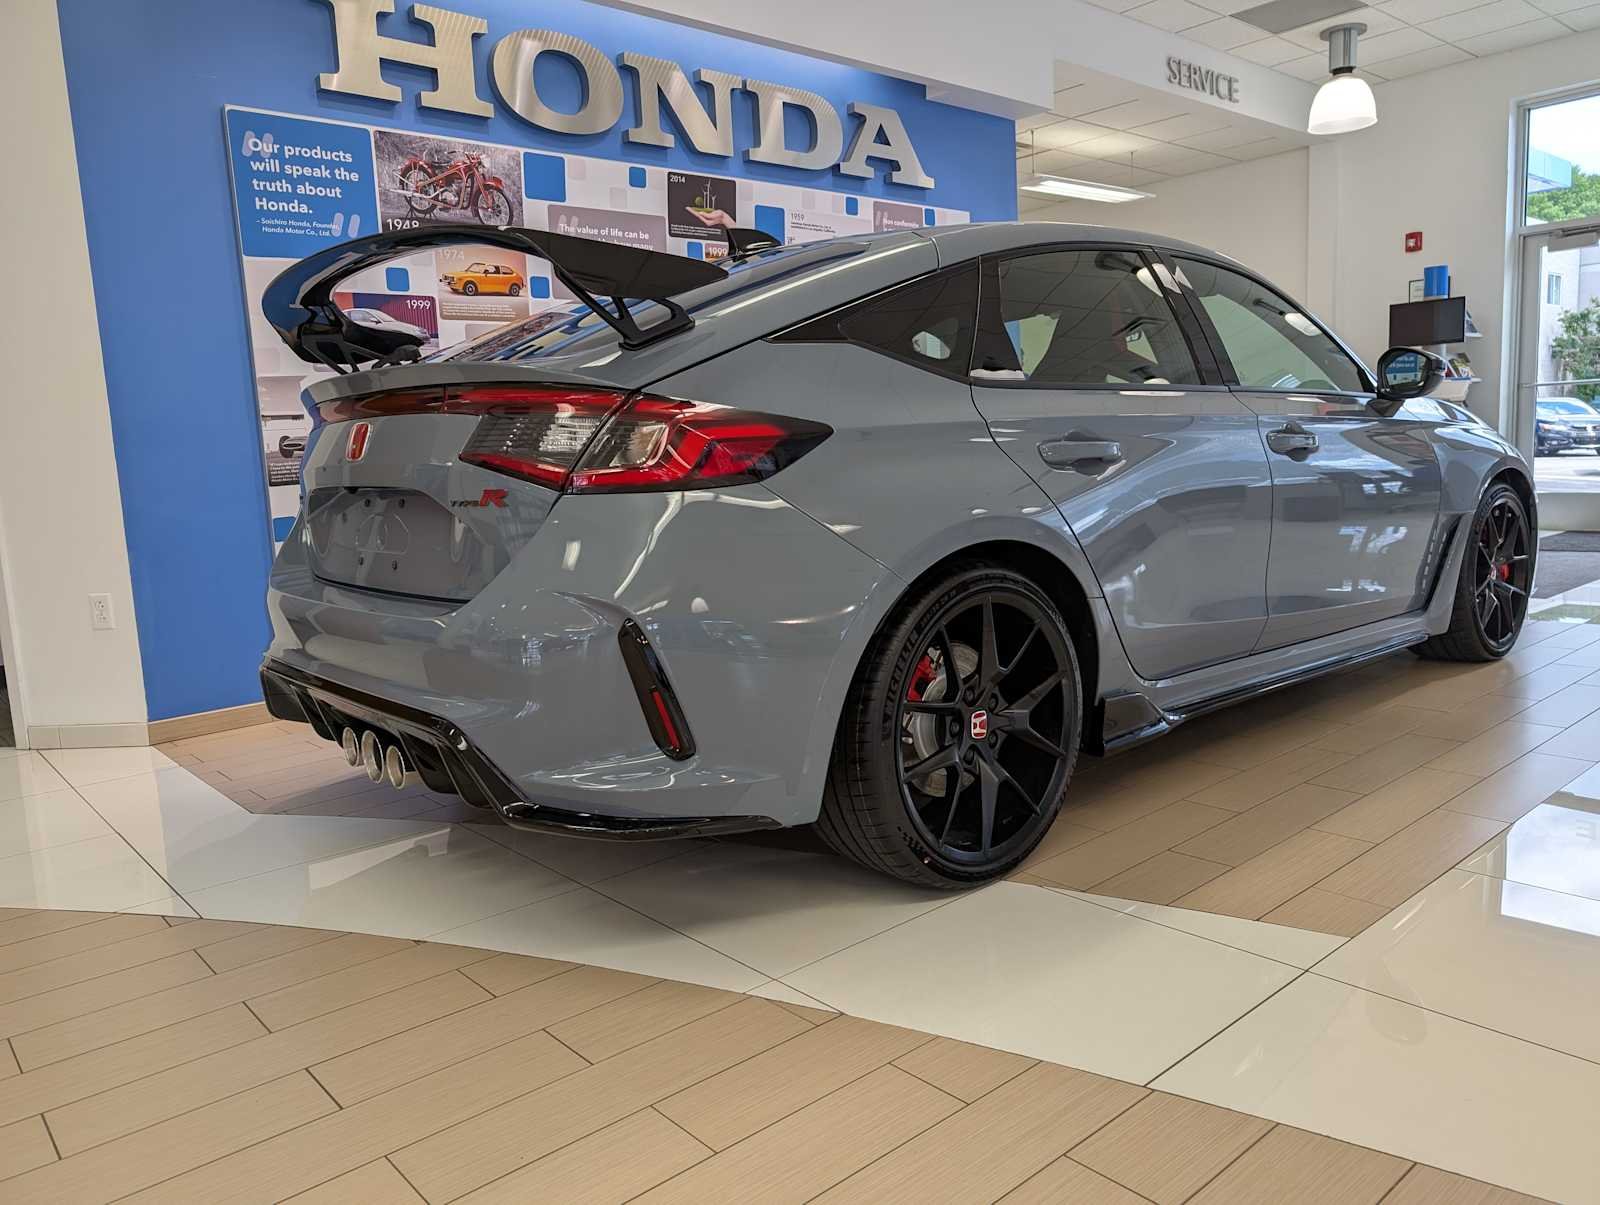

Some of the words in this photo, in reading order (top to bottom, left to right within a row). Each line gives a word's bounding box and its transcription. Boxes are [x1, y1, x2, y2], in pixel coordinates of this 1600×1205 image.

[1167, 56, 1240, 103] SERVICE
[317, 0, 936, 190] HONDA
[248, 138, 280, 154] Our
[284, 145, 353, 163] products
[250, 158, 280, 173] will
[284, 164, 331, 178] speak
[334, 166, 359, 181] the
[252, 178, 292, 193] truth
[296, 181, 342, 198] about
[670, 175, 686, 184] 2014
[255, 197, 313, 214] Honda.
[791, 212, 805, 222] 1959
[262, 225, 284, 233] Honda
[285, 227, 305, 235] Motor
[559, 223, 576, 233] The
[576, 224, 599, 235] value
[600, 227, 609, 236] of
[610, 228, 623, 237] life
[624, 231, 638, 239] can
[639, 231, 649, 240] be
[708, 246, 728, 257] 1999
[406, 299, 431, 310] 1999
